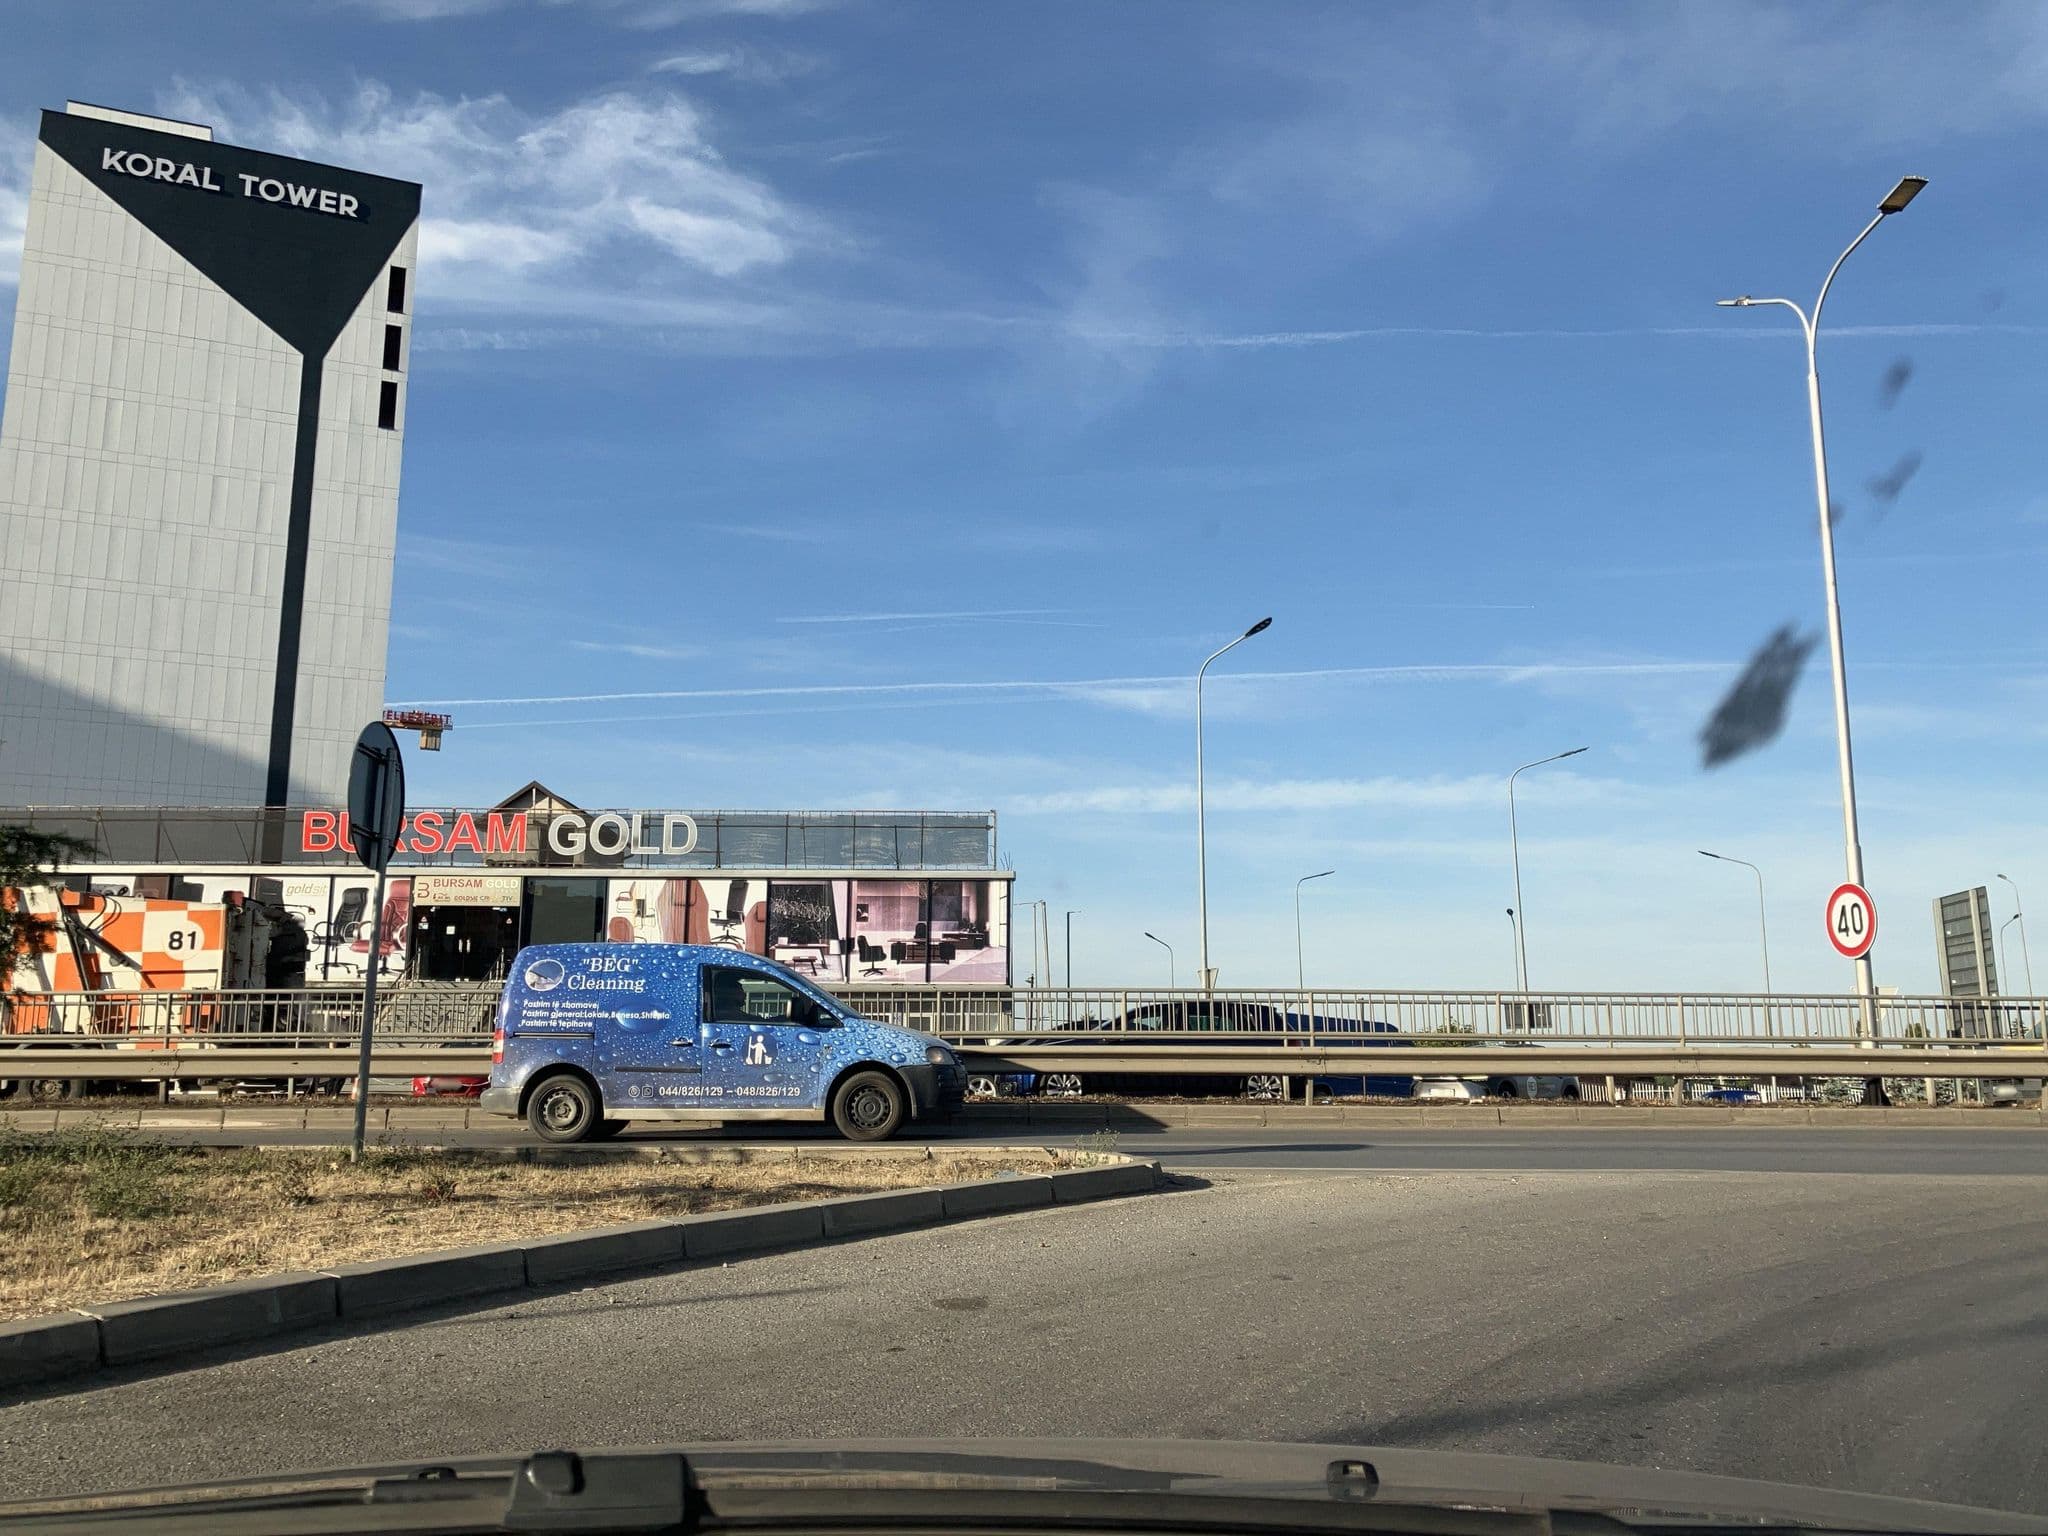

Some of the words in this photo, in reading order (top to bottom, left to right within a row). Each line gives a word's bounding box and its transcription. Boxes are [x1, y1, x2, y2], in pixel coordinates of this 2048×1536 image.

[101, 147, 221, 191] KORAL
[238, 172, 359, 218] TOWER
[301, 810, 527, 854] BSAM
[547, 813, 699, 856] GOLD
[285, 883, 328, 897] goldsit
[433, 878, 483, 888] BURSAM
[485, 879, 519, 889] GOLD
[1837, 902, 1864, 937] 40
[168, 930, 197, 951] 81
[583, 957, 640, 973] "BEG"
[567, 974, 646, 993] Cleaning
[523, 999, 551, 1009] Pastrim
[522, 1010, 550, 1018] Pastrim
[520, 1019, 549, 1028] Pastrim
[658, 1085, 724, 1097] 044/826/129
[735, 1086, 801, 1098] 048/826/129
